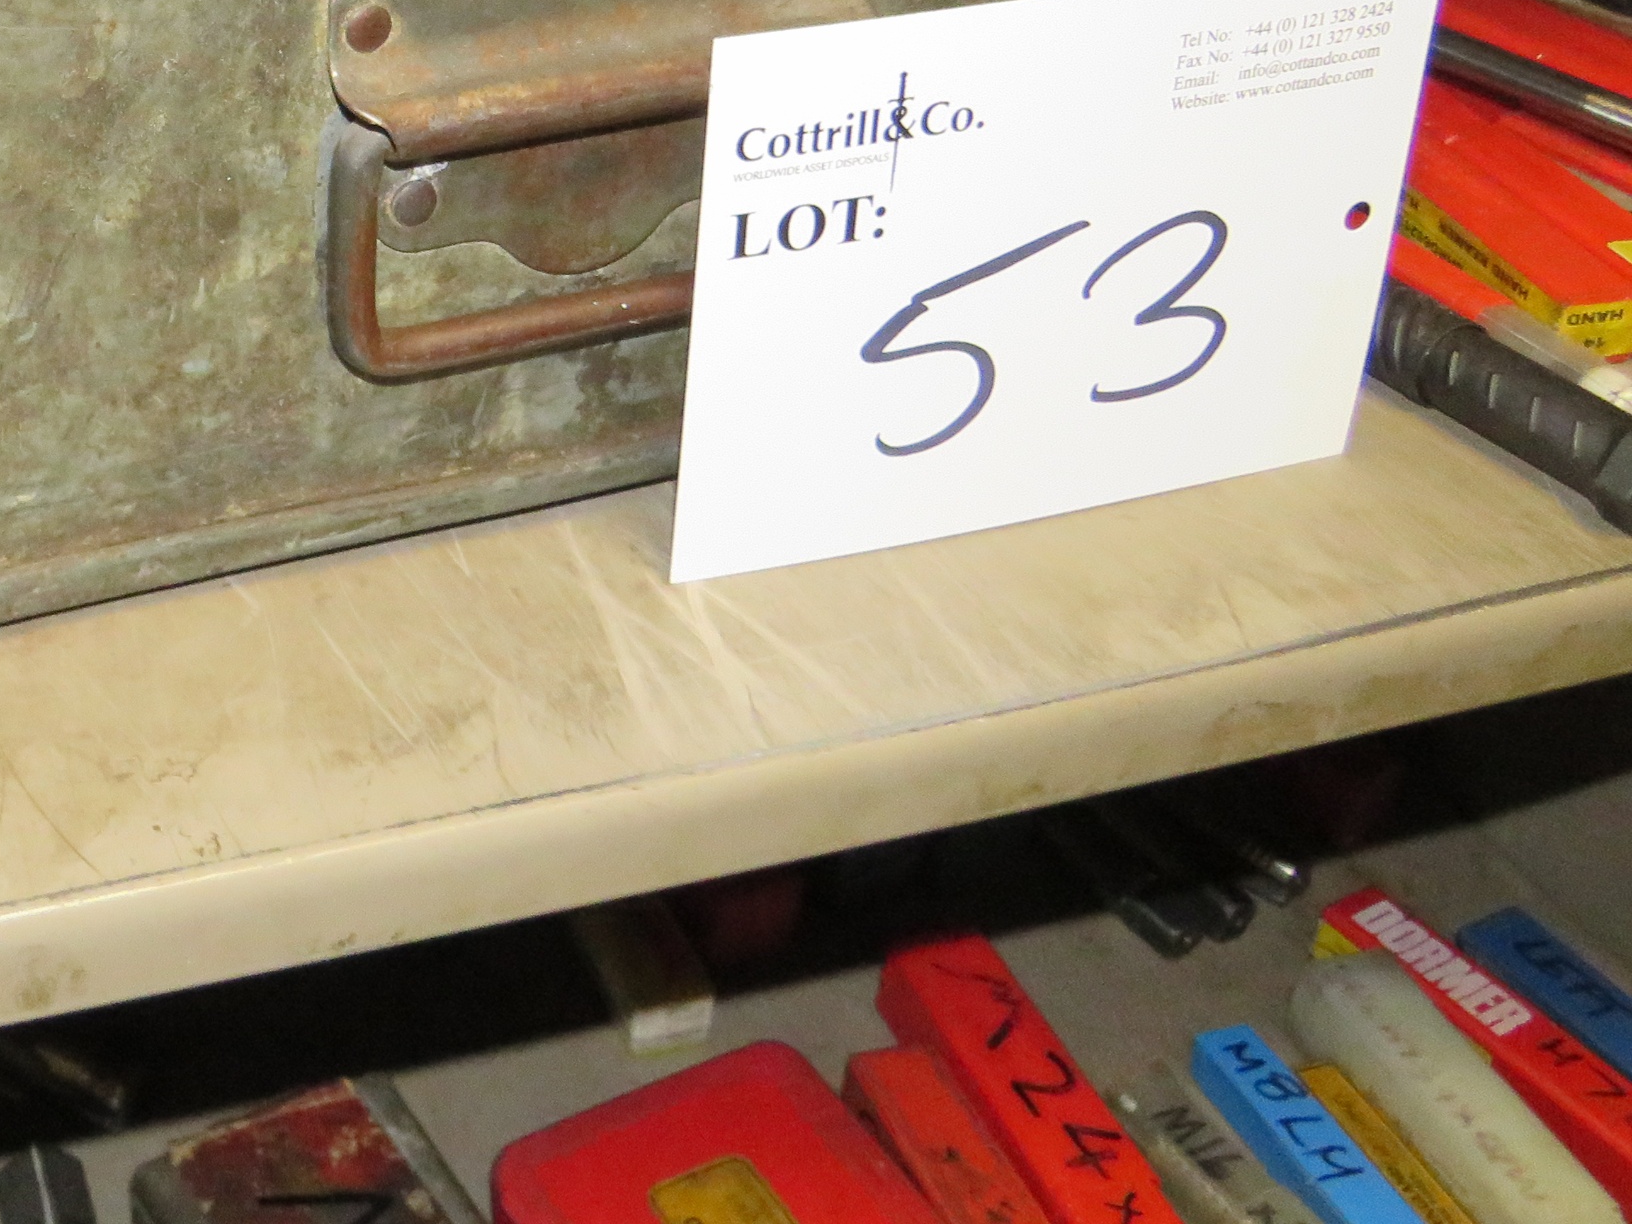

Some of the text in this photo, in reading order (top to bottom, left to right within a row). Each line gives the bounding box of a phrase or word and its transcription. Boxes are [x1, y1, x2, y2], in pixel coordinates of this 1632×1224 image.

[1176, 21, 1391, 70] Fax No: +44 (0) 121 327 9550
[1181, 1, 1394, 49] Tel No: +44 (0) 121 328 2424
[1171, 68, 1374, 110] Website: www.cottandco.com
[1173, 46, 1380, 92] Email: info@cottandco.com
[733, 152, 890, 183] WORLDWIDE ASSET DISPOSALS
[727, 195, 886, 260] LOT:
[860, 209, 1228, 457] 53
[1567, 309, 1624, 326] HAND
[1352, 899, 1533, 1037] DORMER
